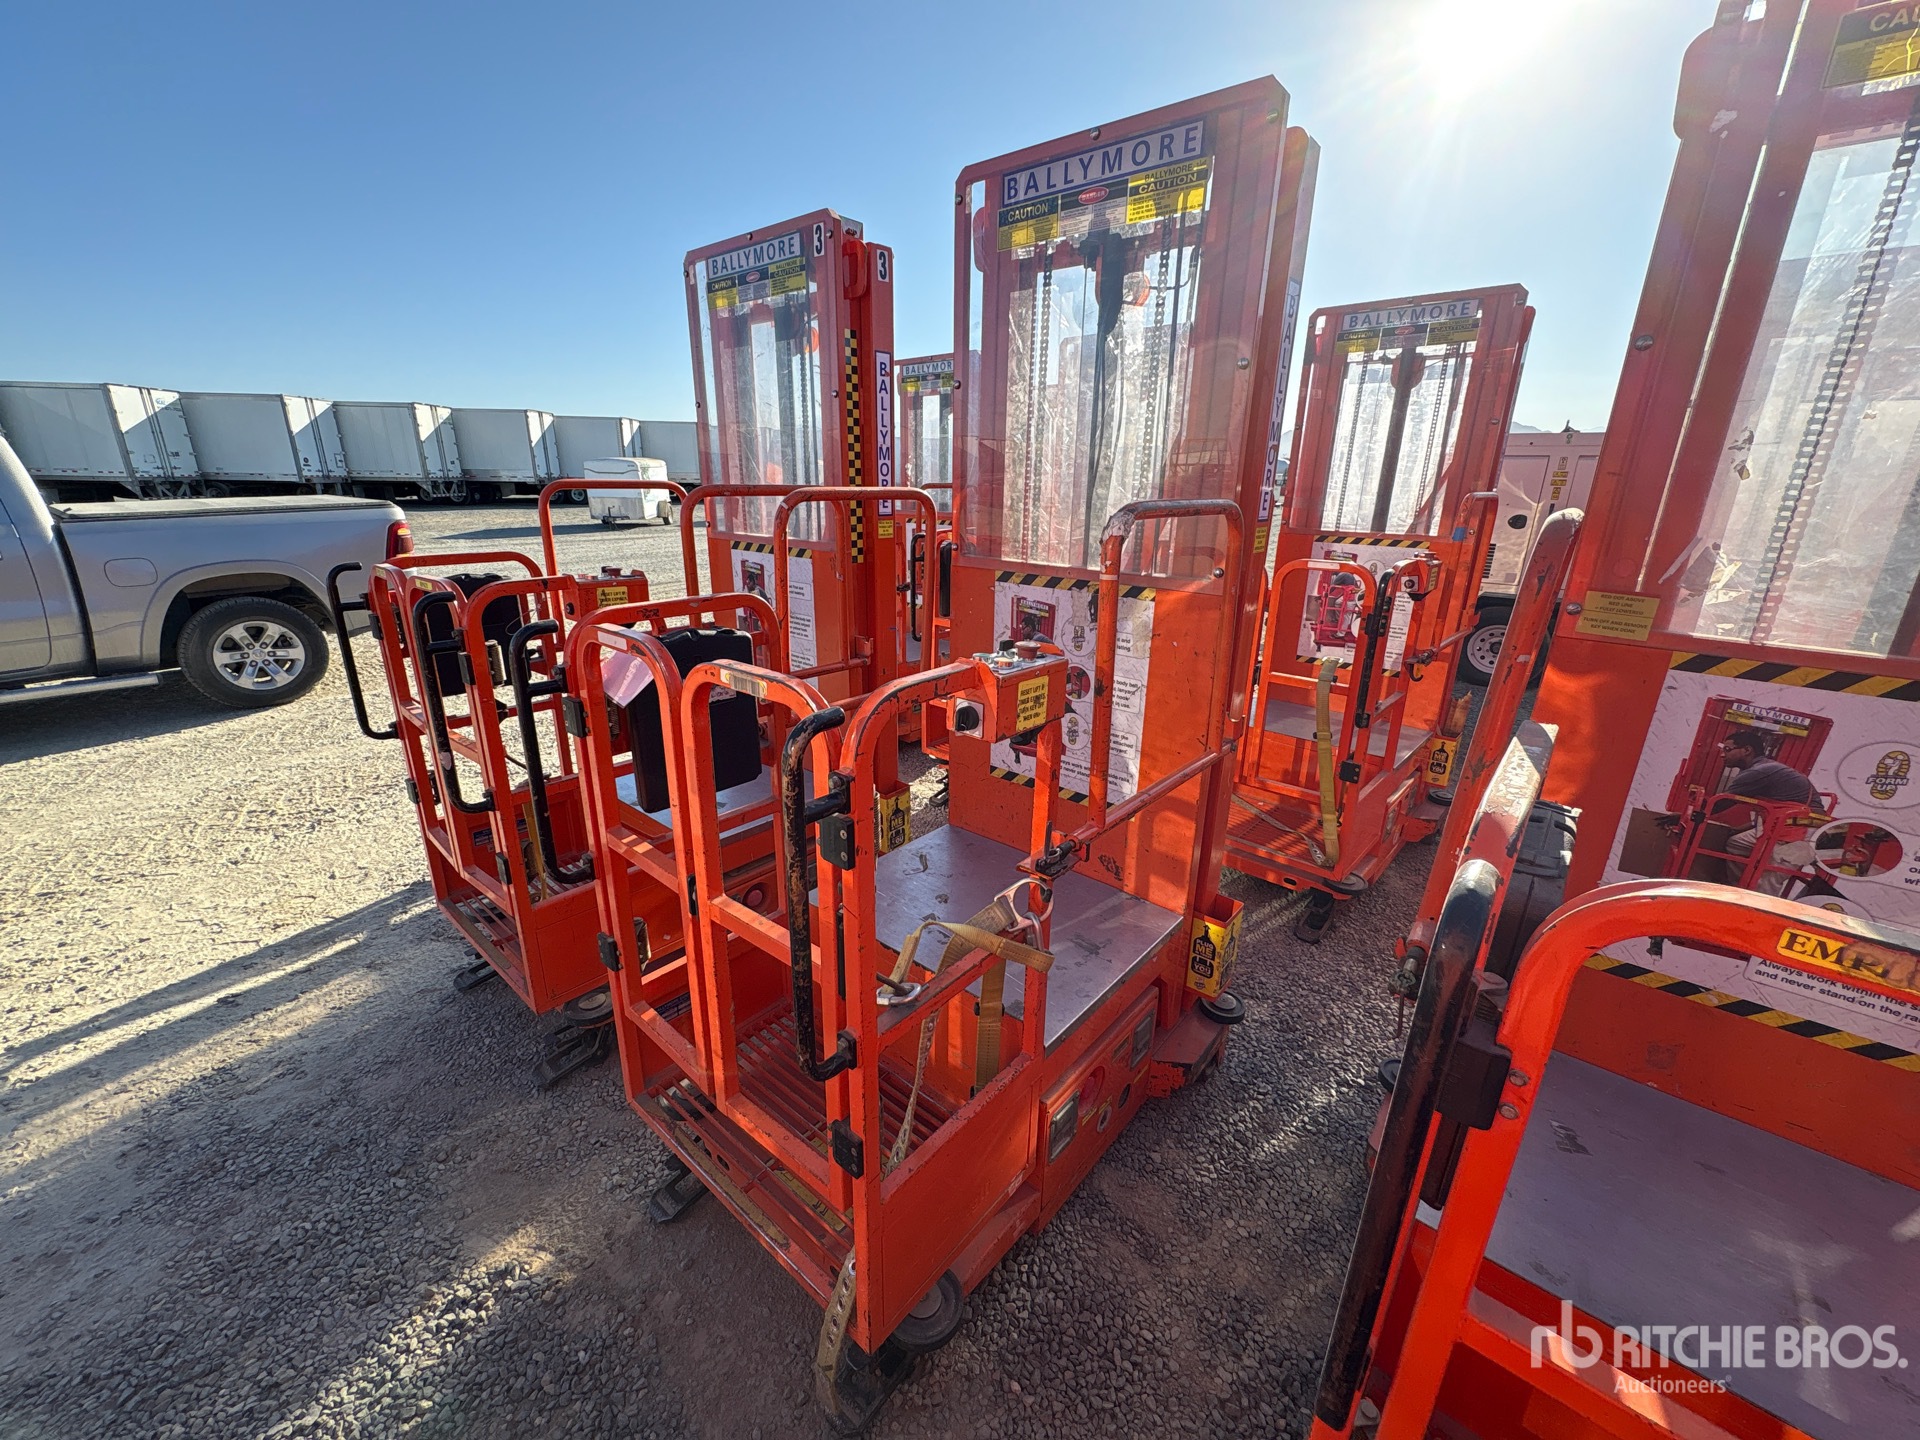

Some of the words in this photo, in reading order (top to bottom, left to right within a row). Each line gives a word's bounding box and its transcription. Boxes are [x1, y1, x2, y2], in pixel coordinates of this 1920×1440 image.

[1869, 4, 1920, 32] CA
[1006, 124, 1199, 201] BALLYMORE
[1138, 173, 1197, 194] CAUTION
[1008, 202, 1049, 222] CAUTION
[814, 224, 823, 255] 3
[712, 236, 796, 276] BALLYMORE
[878, 251, 888, 282] 3
[1348, 301, 1471, 328] BALLYMORE
[1344, 331, 1373, 340] CAUTION
[905, 361, 952, 375] BALLYMOR
[1261, 299, 1296, 511] BALLYMORE
[1624, 621, 1648, 629] REMOVE
[1736, 703, 1807, 725] BALLYMORE
[1866, 777, 1908, 785] FORM
[1195, 944, 1213, 955] ME
[1196, 938, 1214, 950] PLUG
[1194, 962, 1211, 974] YOU
[1758, 959, 1803, 977] Always
[1806, 971, 1838, 987] work
[1754, 968, 1778, 980] and
[1780, 977, 1816, 991] never
[1818, 987, 1856, 1004] stand
[1858, 999, 1877, 1010] on
[1880, 1004, 1901, 1017] the
